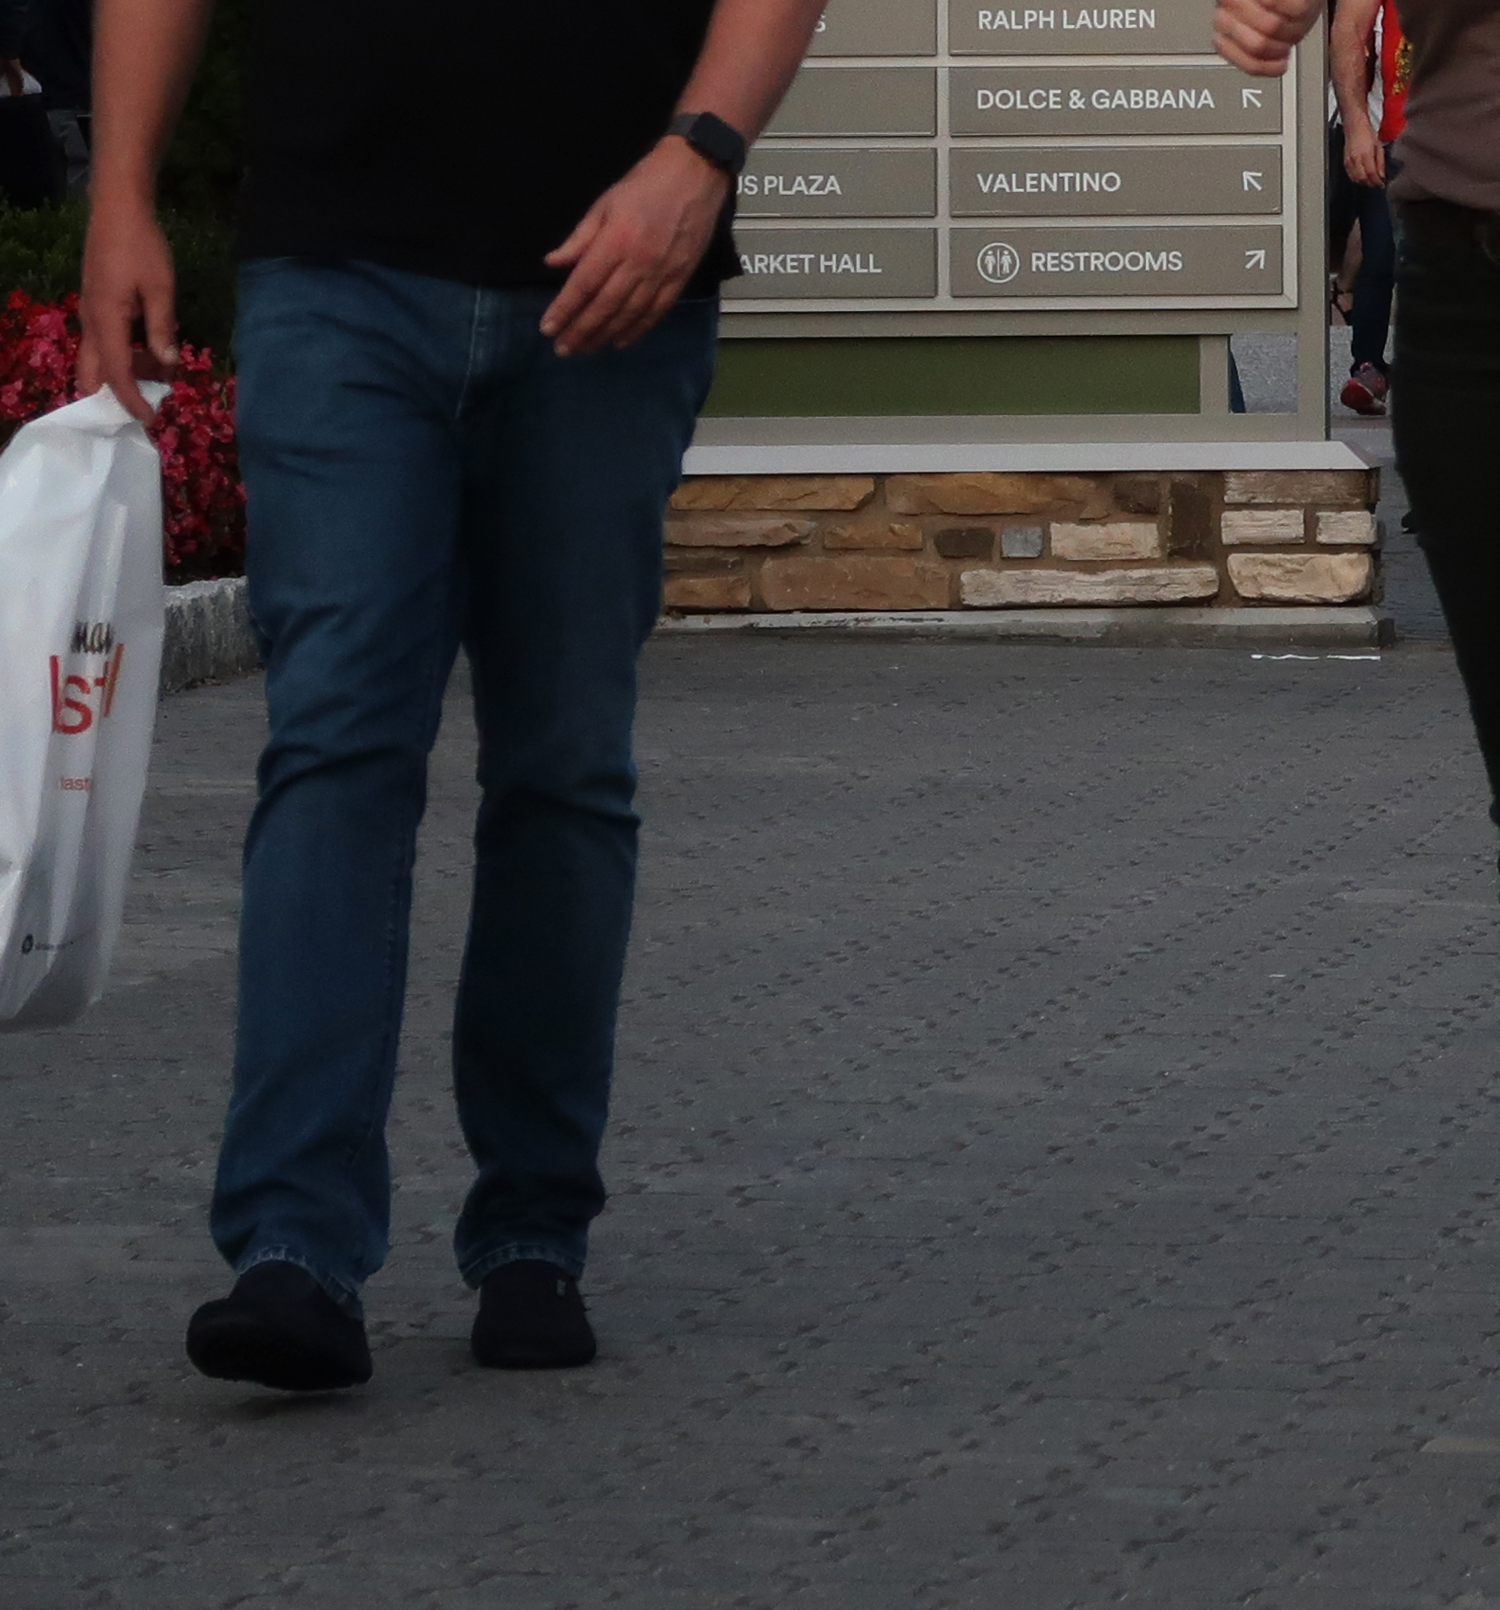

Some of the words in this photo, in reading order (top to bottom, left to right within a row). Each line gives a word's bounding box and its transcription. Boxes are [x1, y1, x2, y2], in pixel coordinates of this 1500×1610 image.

[978, 10, 1055, 30] RALPH
[1062, 9, 1155, 29] LAUREN
[977, 89, 1062, 109] DOLCE
[1068, 89, 1086, 109] &
[1091, 88, 1216, 109] GABBANA
[764, 175, 842, 196] PLAZA
[976, 172, 1122, 193] VALENTINO
[740, 254, 814, 275] ARKET
[819, 253, 883, 274] HALL
[1031, 251, 1183, 272] RESTROOMS
